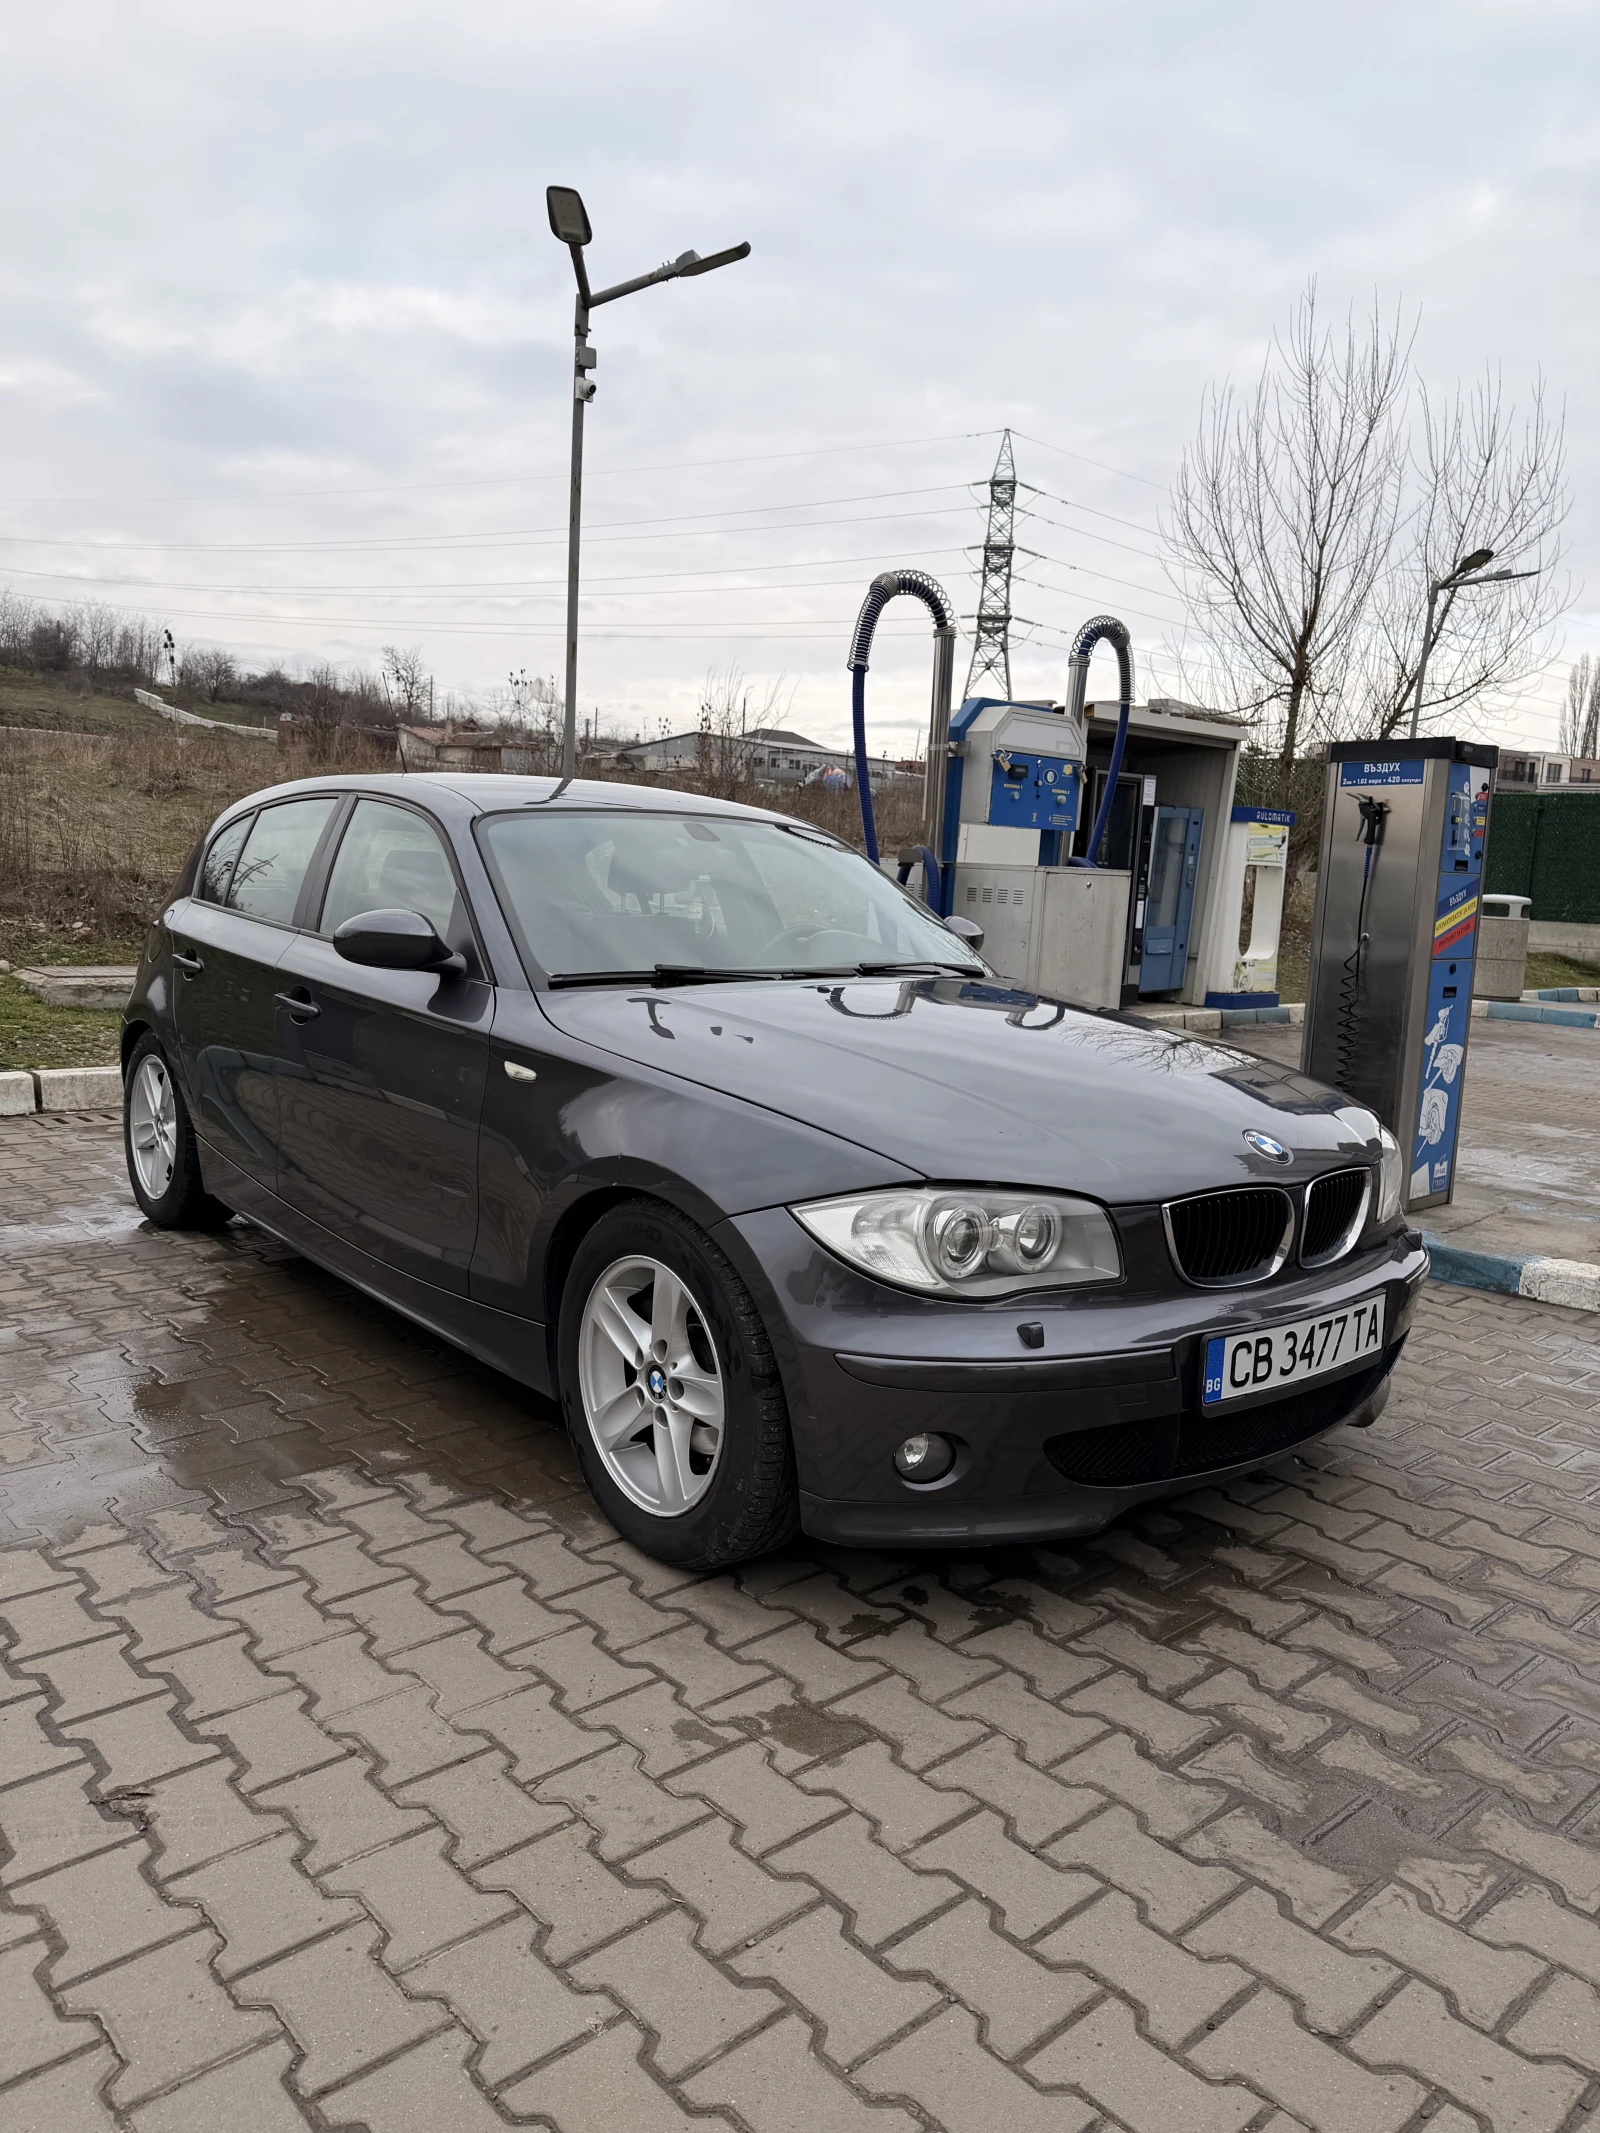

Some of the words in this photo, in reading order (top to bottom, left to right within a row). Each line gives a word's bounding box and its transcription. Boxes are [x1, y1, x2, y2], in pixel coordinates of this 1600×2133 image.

[1363, 762, 1400, 773] ВЪЗДУХ
[1449, 888, 1467, 907] ВЪЗДУХ
[1229, 1336, 1273, 1388] CB
[1279, 1314, 1348, 1376] 3477
[1353, 1303, 1378, 1353] TA
[1205, 1377, 1221, 1394] BG
